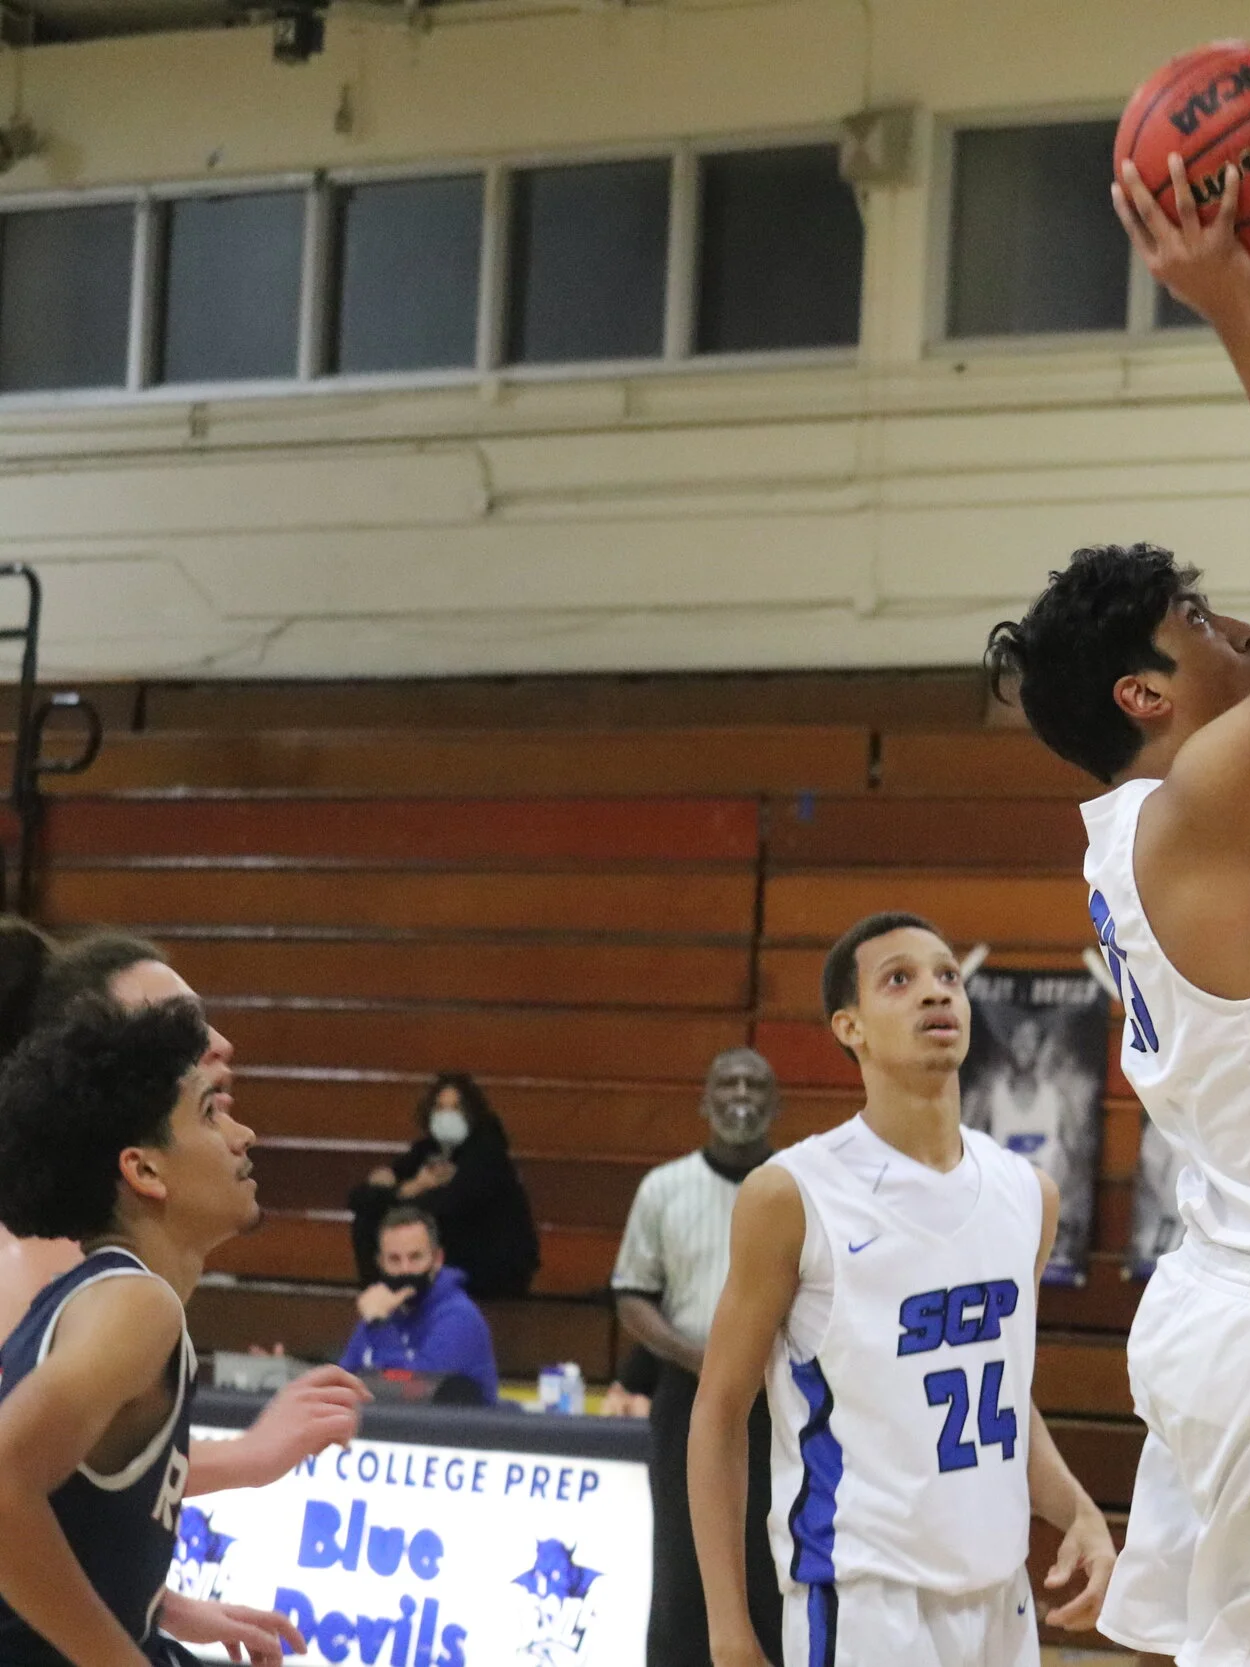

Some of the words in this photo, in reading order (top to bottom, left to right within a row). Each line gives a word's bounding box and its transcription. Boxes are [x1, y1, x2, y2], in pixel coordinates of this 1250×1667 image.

[896, 1278, 1019, 1358] SCP
[923, 1360, 1018, 1474] 24
[335, 1449, 488, 1493] COLLEGE
[503, 1462, 600, 1503] PREP
[297, 1498, 445, 1581] Blue
[273, 1585, 468, 1667] Devils
